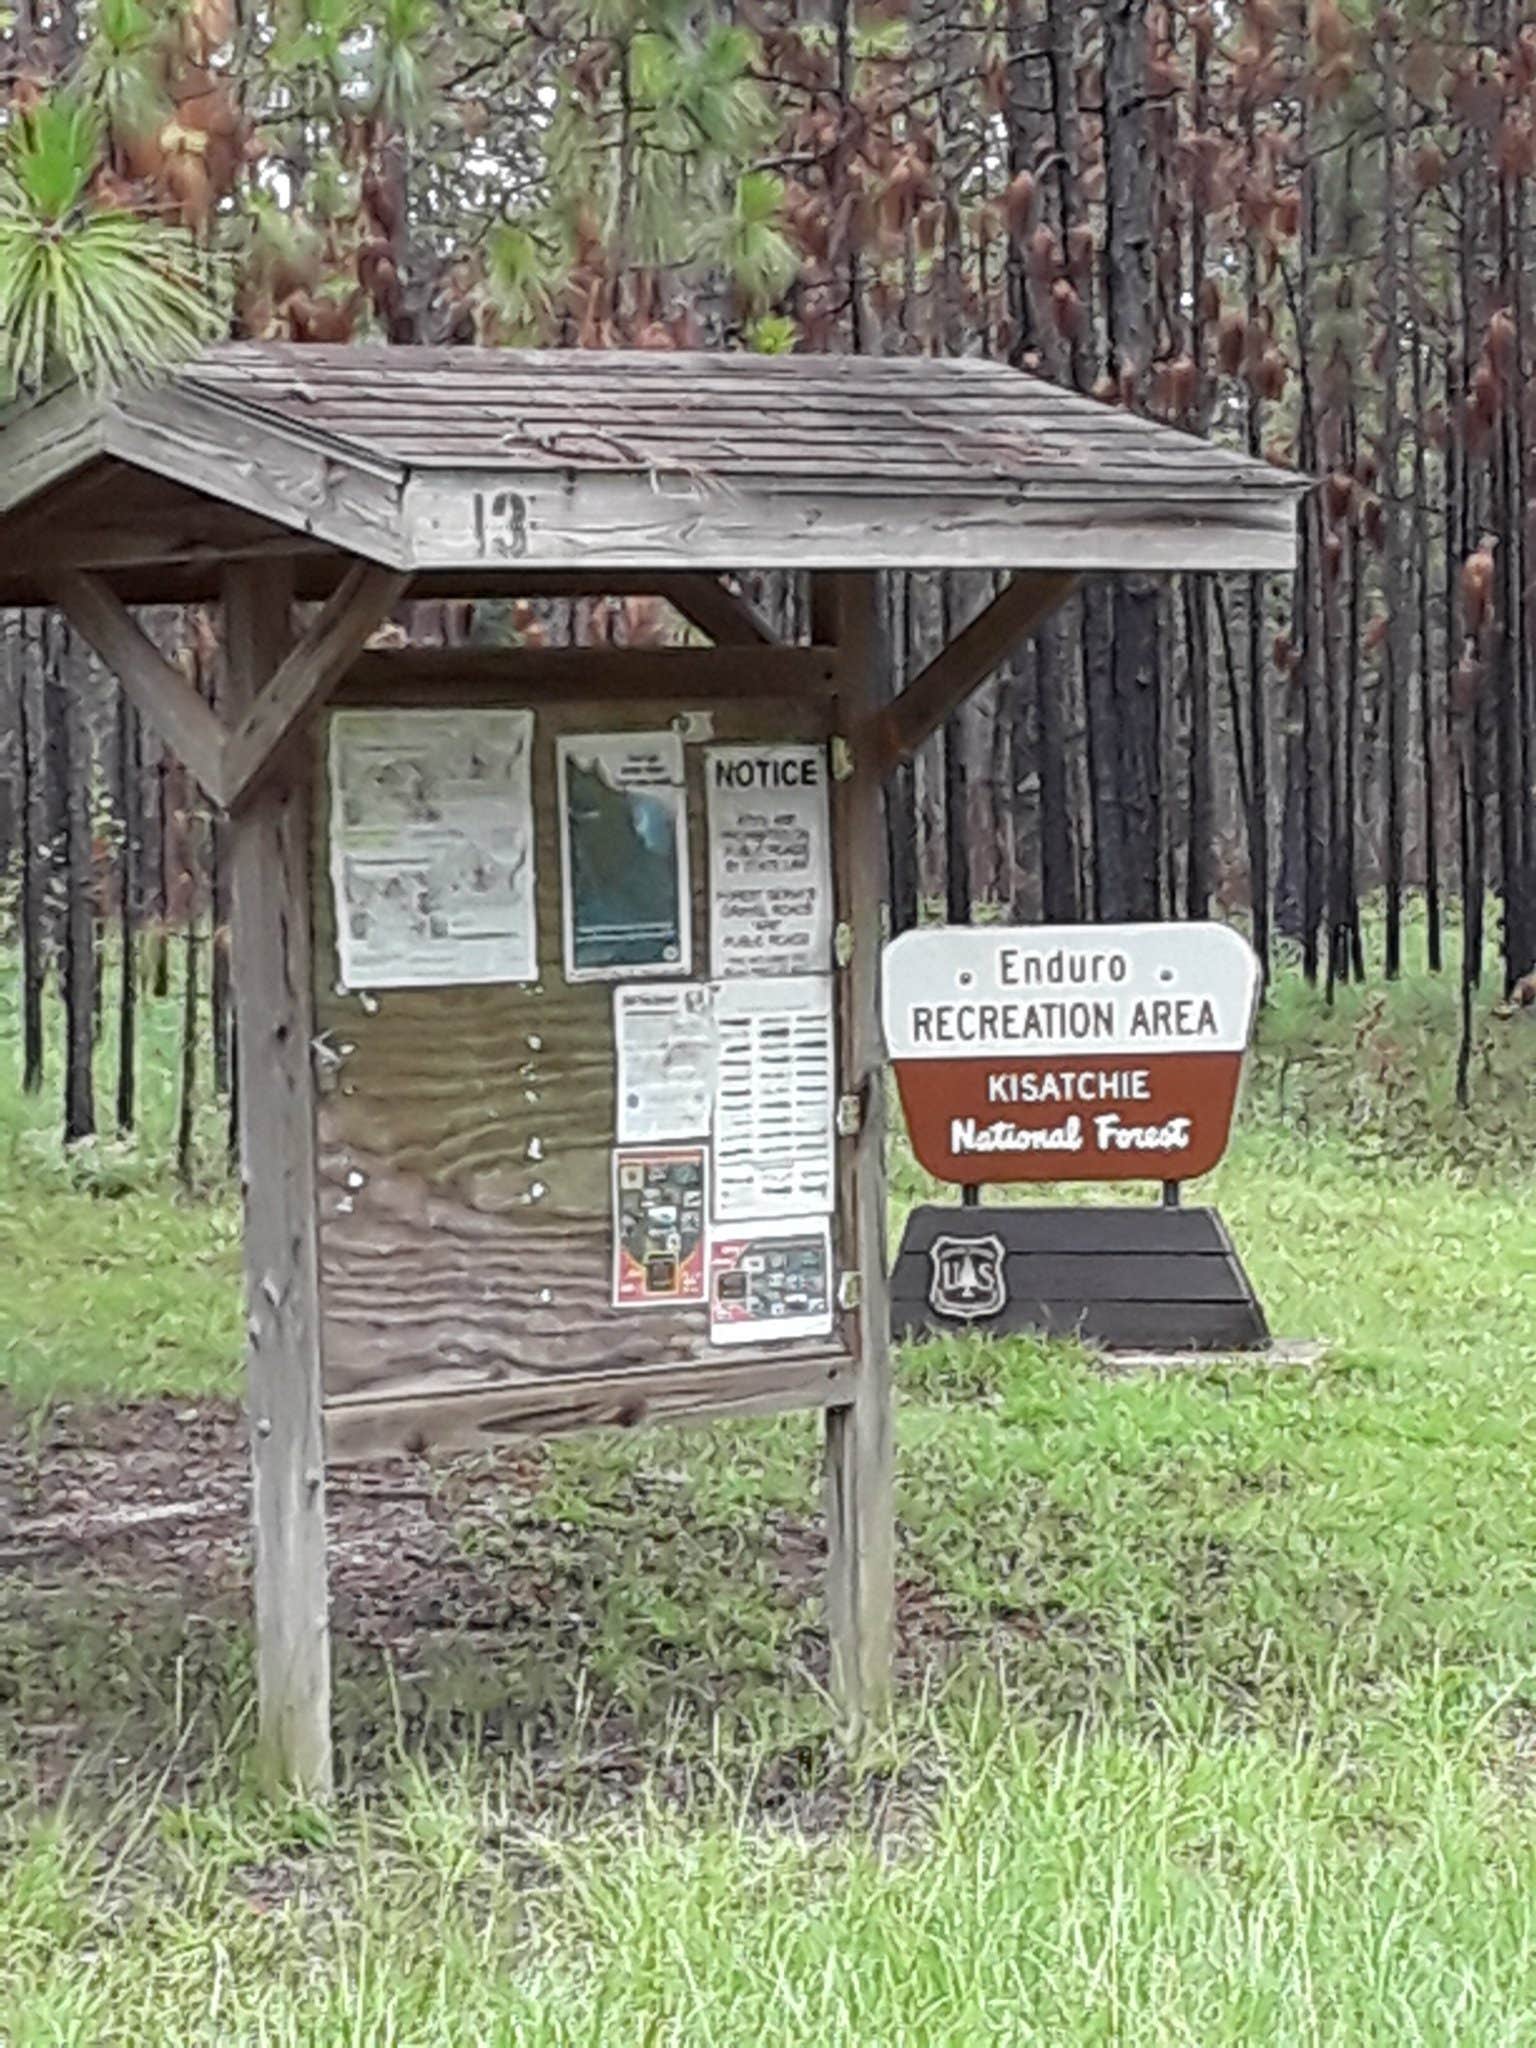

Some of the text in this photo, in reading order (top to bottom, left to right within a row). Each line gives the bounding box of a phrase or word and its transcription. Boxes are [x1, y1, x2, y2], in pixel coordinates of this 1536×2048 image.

[474, 492, 527, 559] 13
[714, 758, 818, 789] NOTICE
[1000, 949, 1127, 985] Enduro
[912, 999, 1219, 1042] RECREATION AREA
[987, 1069, 1152, 1103] KISATCHIE
[949, 1112, 1193, 1156] National Forest
